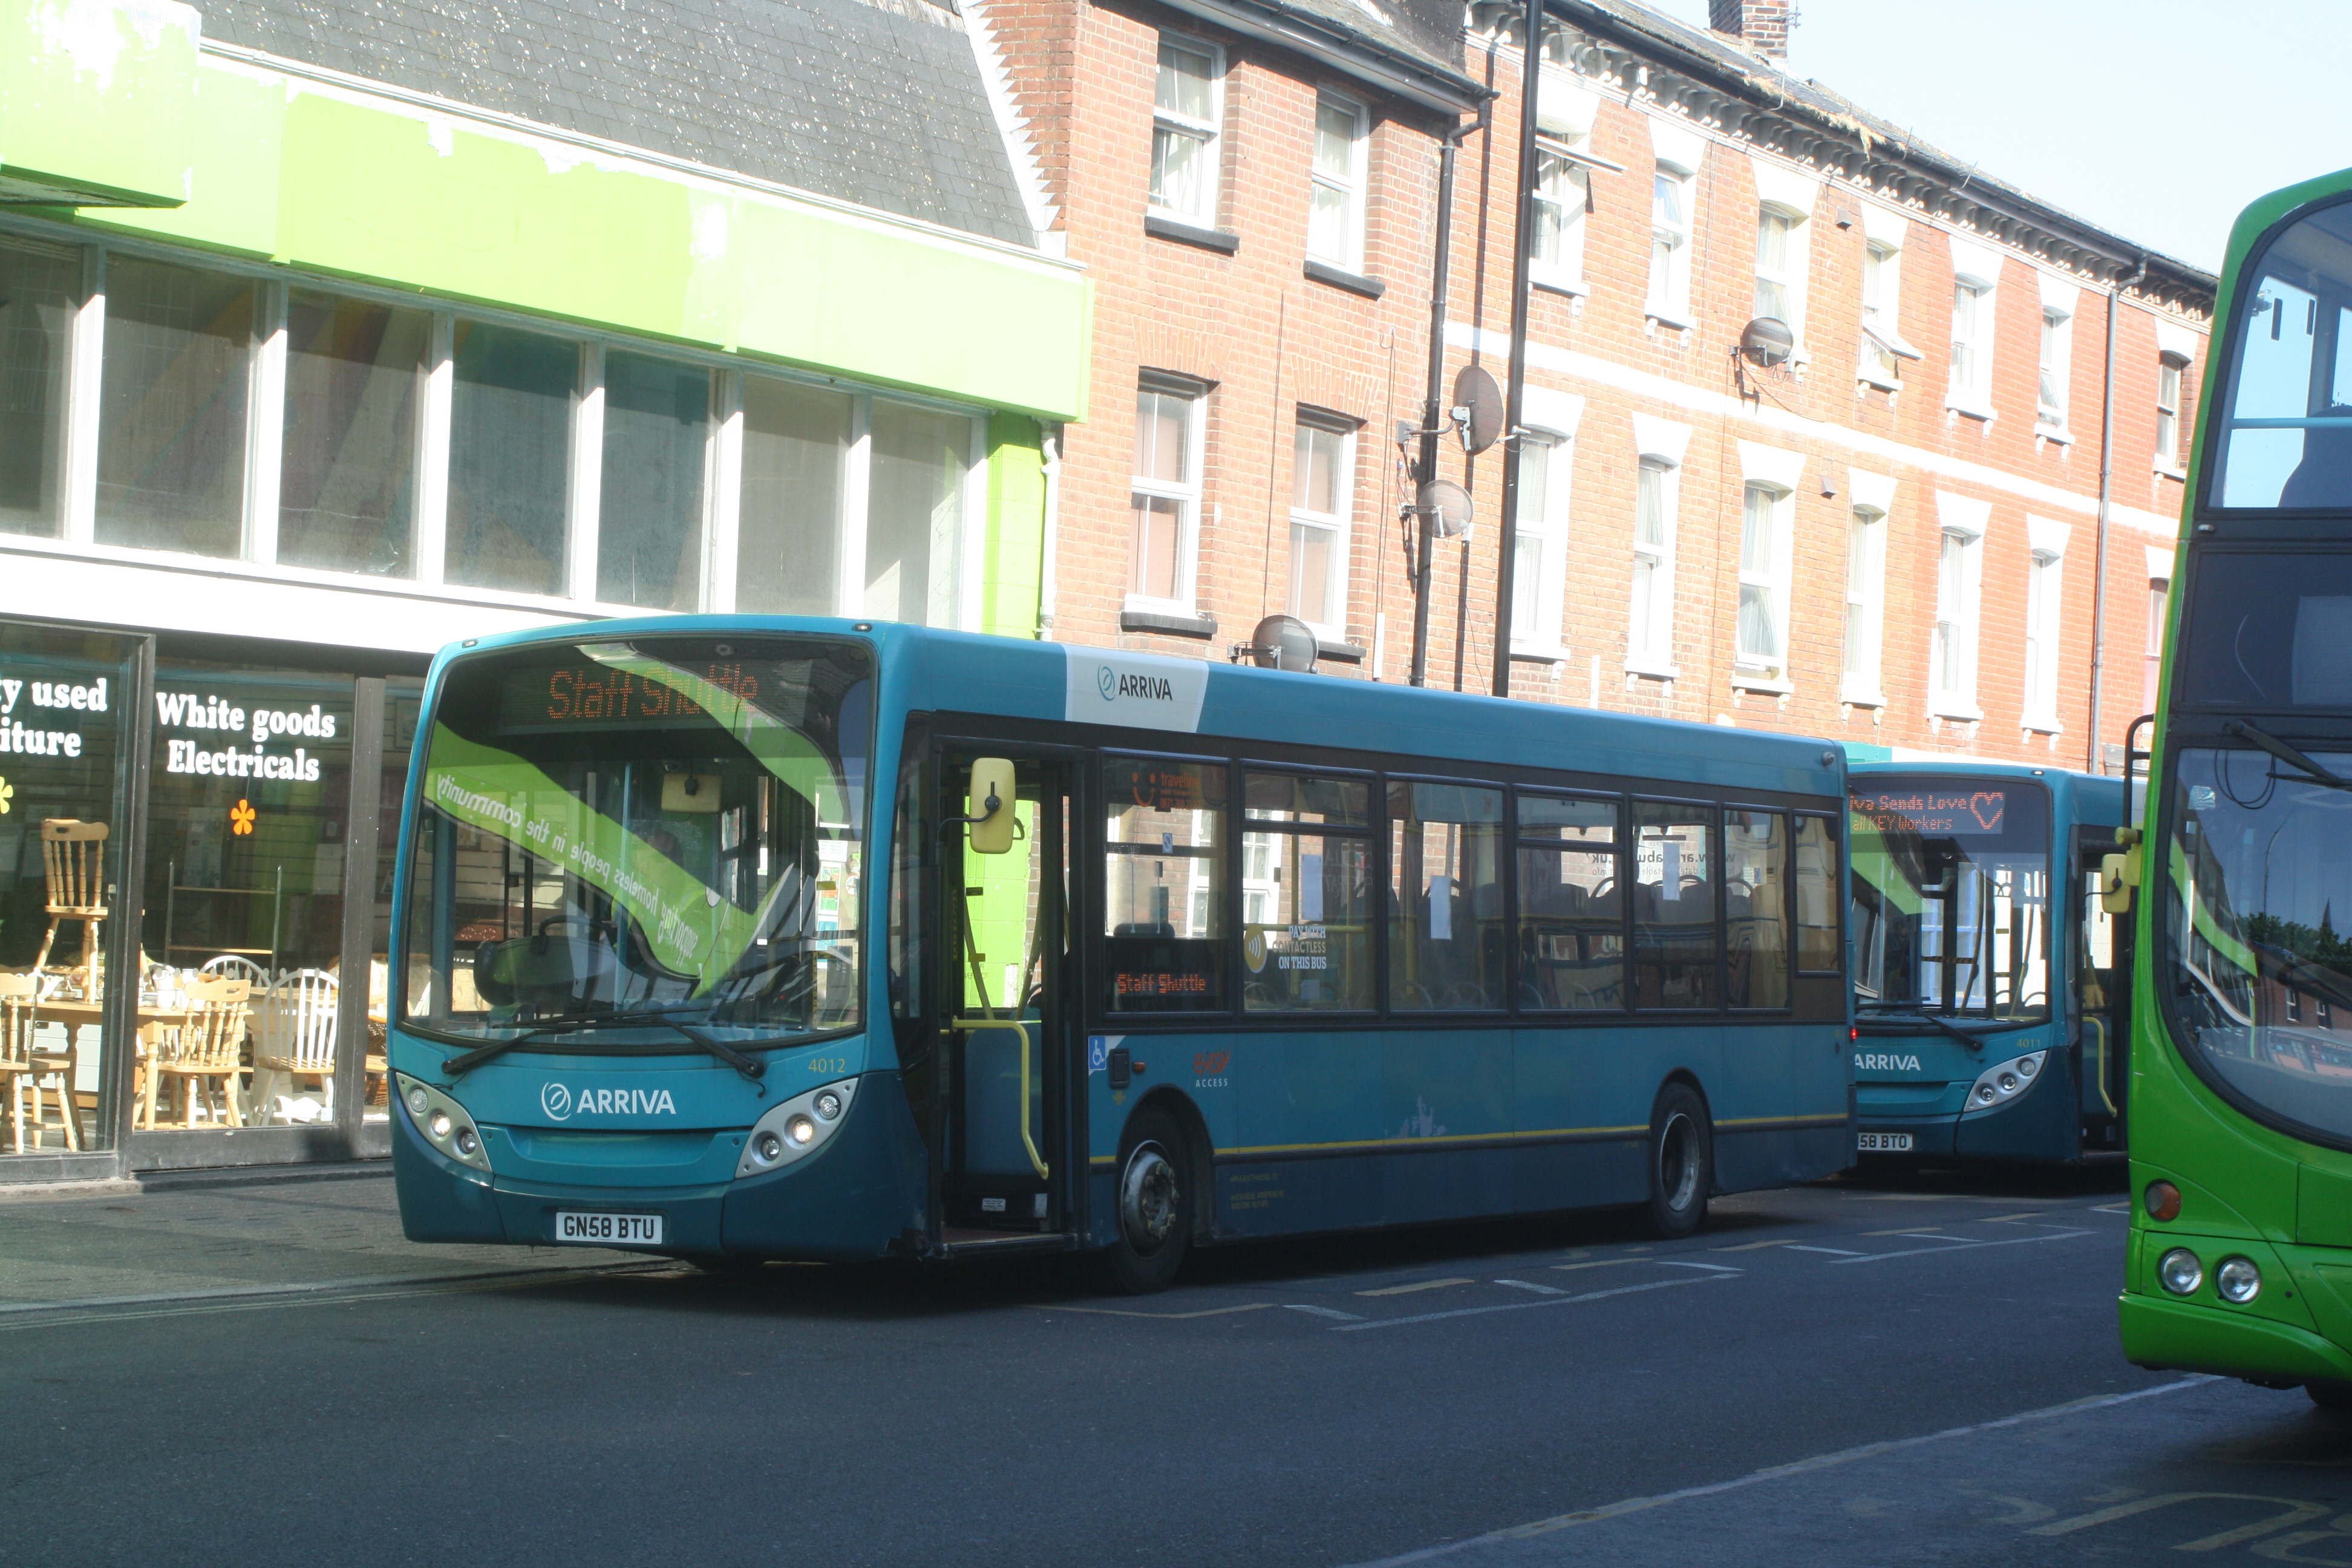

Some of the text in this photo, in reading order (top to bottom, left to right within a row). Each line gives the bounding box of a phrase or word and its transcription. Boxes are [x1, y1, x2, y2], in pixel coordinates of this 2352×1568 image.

[31, 678, 108, 711] used
[548, 664, 757, 719] Staff Shuttle
[1119, 673, 1173, 701] ARRIVA
[156, 692, 336, 742] White goods
[167, 740, 320, 782] Electricals
[1160, 772, 1201, 788] traveline
[1880, 795, 1924, 811] Sends
[1928, 795, 1967, 809] Love
[1852, 815, 1953, 831] all KEY Workers
[1288, 925, 1326, 938] PAY WITH
[1272, 941, 1326, 953] CONTACTLESS
[1278, 956, 1327, 969] ON THIS BUS
[1117, 974, 1206, 994] Staff Shuttle
[2016, 1038, 2041, 1048] 4011
[808, 1057, 846, 1073] 4012
[1855, 1054, 1921, 1071] ARRIVA
[1195, 1078, 1228, 1088] ACCESS
[577, 1089, 676, 1116] ARRIVA
[1881, 1135, 1907, 1148] BTO
[563, 1216, 655, 1240] GN58 BTU
